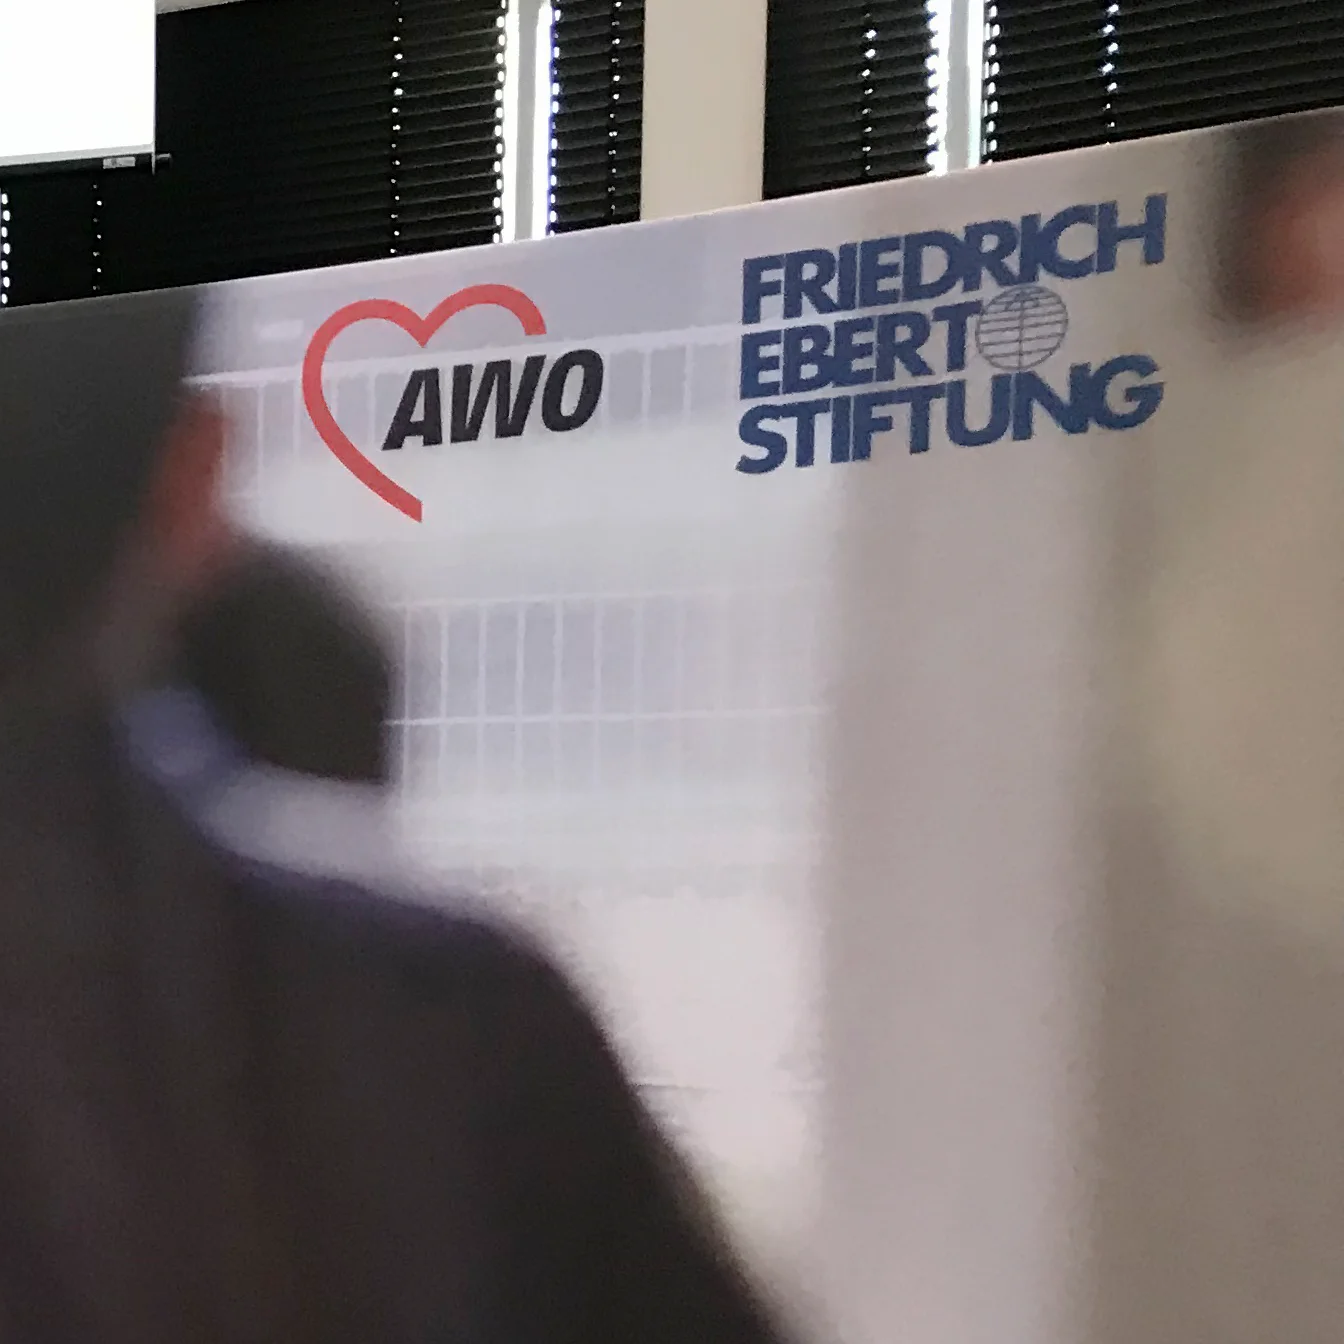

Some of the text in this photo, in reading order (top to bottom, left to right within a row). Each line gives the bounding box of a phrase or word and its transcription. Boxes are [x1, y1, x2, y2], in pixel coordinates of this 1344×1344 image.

[740, 193, 1168, 324] FRIEDRICH
[380, 347, 605, 451] AWO
[738, 302, 976, 401] EBERT
[735, 354, 1164, 475] STIFTUNG
